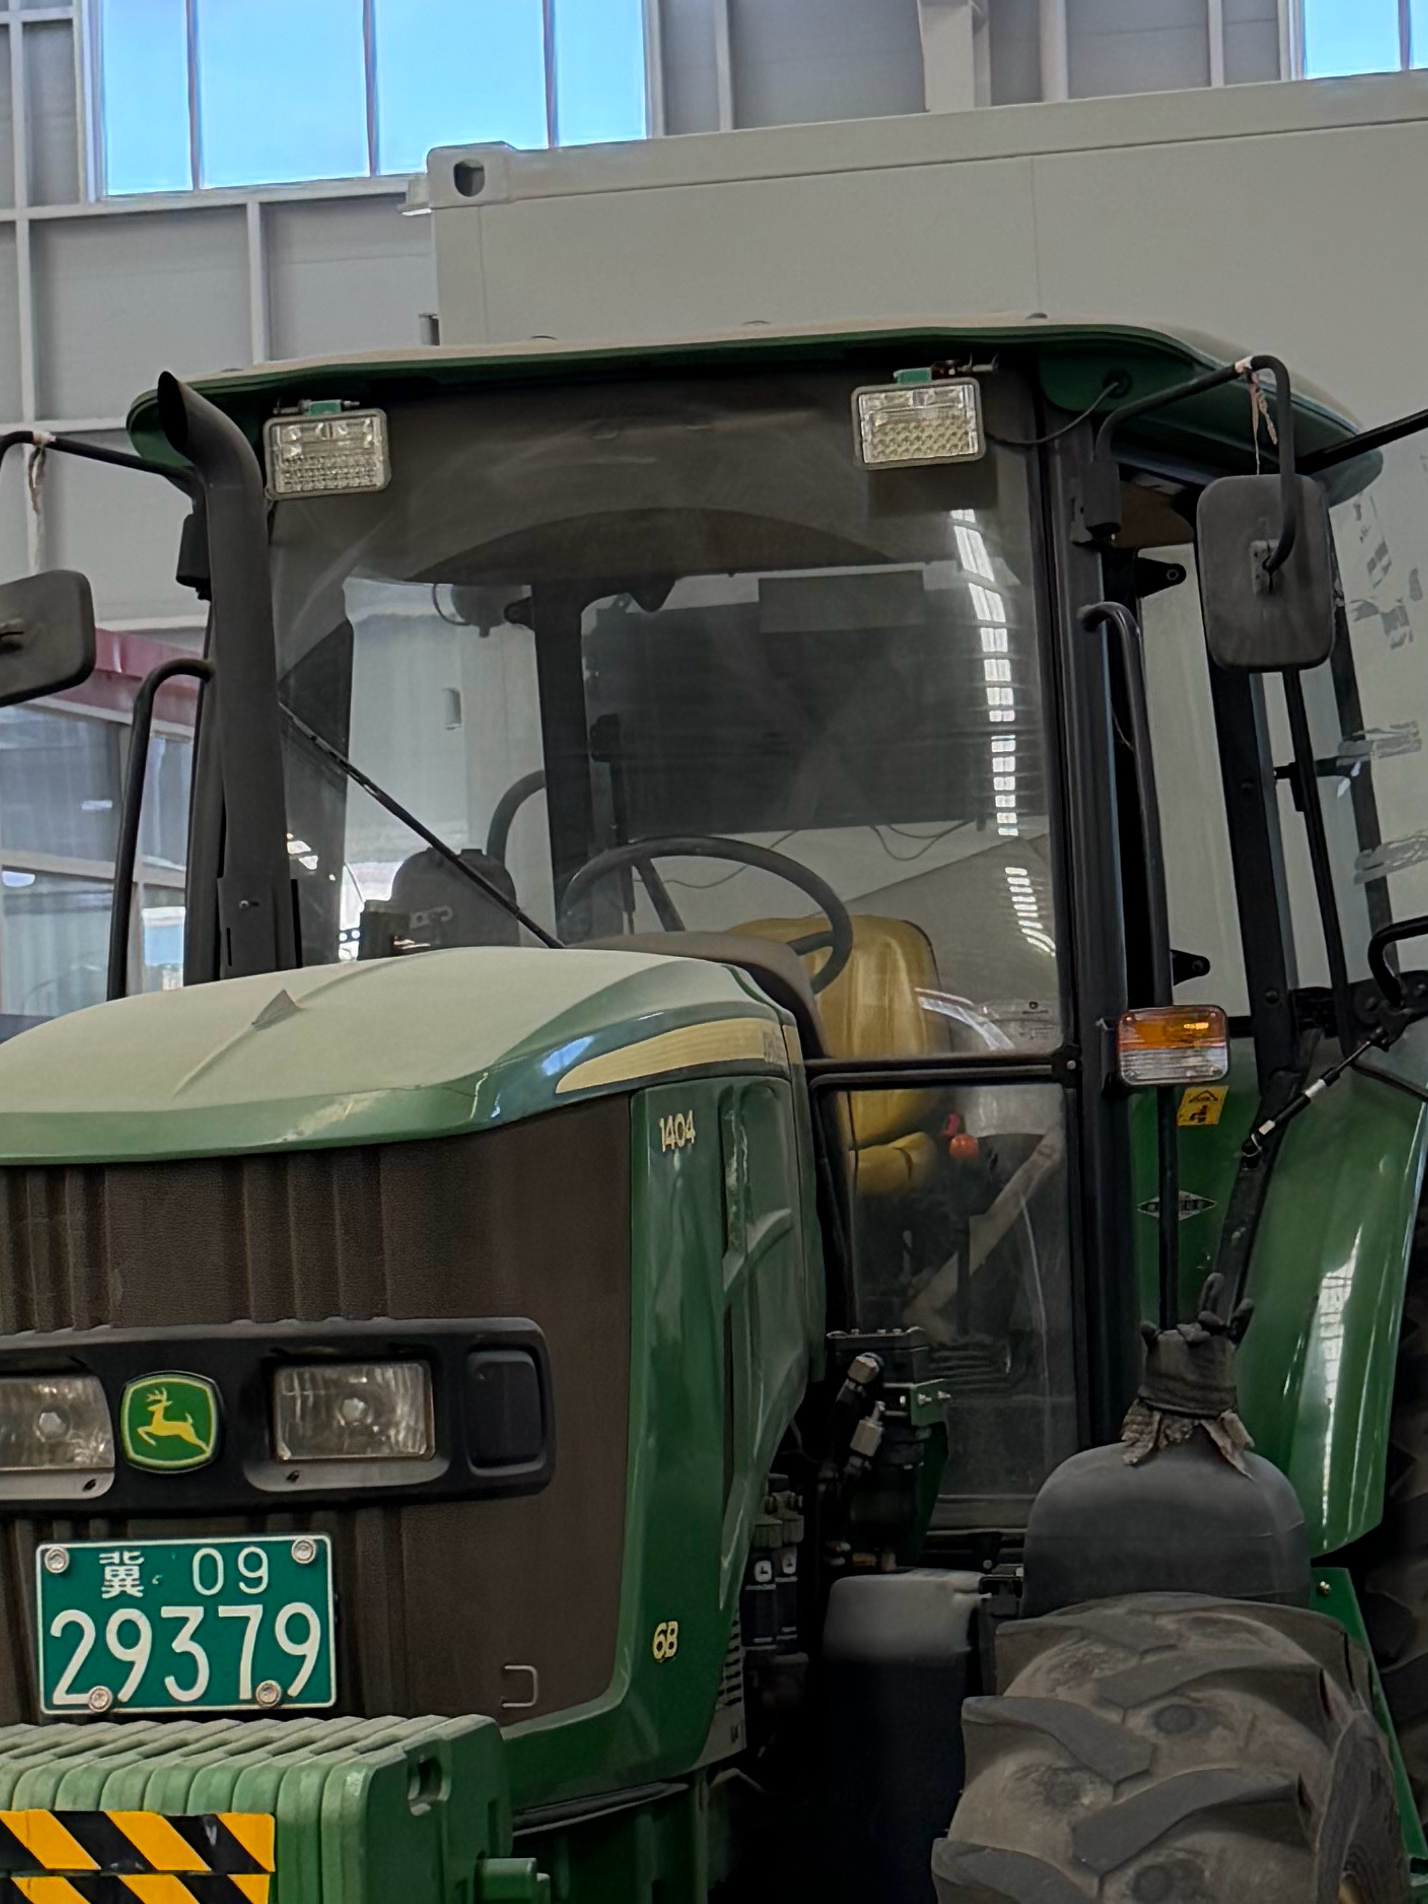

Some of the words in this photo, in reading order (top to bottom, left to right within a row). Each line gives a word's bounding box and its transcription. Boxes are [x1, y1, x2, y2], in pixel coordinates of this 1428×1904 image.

[658, 1109, 696, 1153] 1404
[99, 1550, 145, 1599] 冀
[191, 1546, 269, 1596] 09
[49, 1601, 323, 1706] 29379
[652, 1620, 679, 1660] 6B
